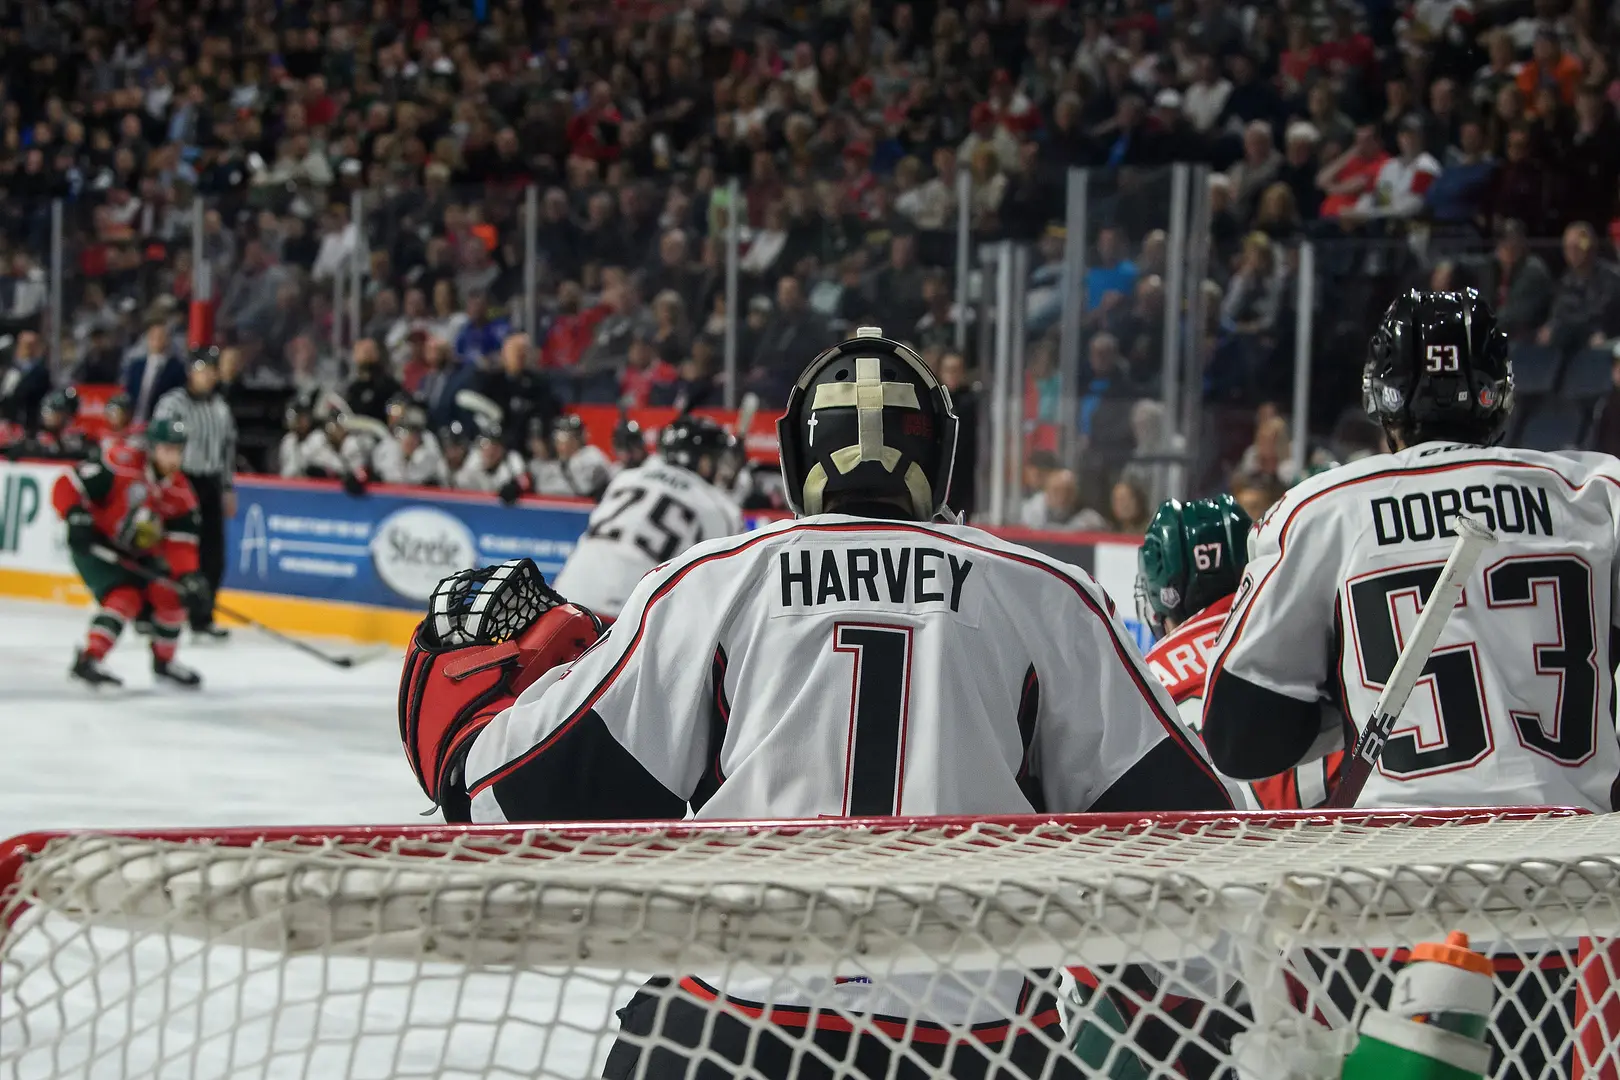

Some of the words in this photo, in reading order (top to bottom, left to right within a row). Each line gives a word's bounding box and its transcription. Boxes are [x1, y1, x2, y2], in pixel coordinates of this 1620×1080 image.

[1426, 345, 1459, 372] 53
[588, 486, 696, 563] 25
[1371, 484, 1553, 546] DOBSON
[780, 547, 973, 612] HARVEY
[1194, 542, 1222, 571] 67
[1346, 552, 1599, 781] 53
[822, 622, 914, 817] 1
[1400, 976, 1416, 1005] 1
